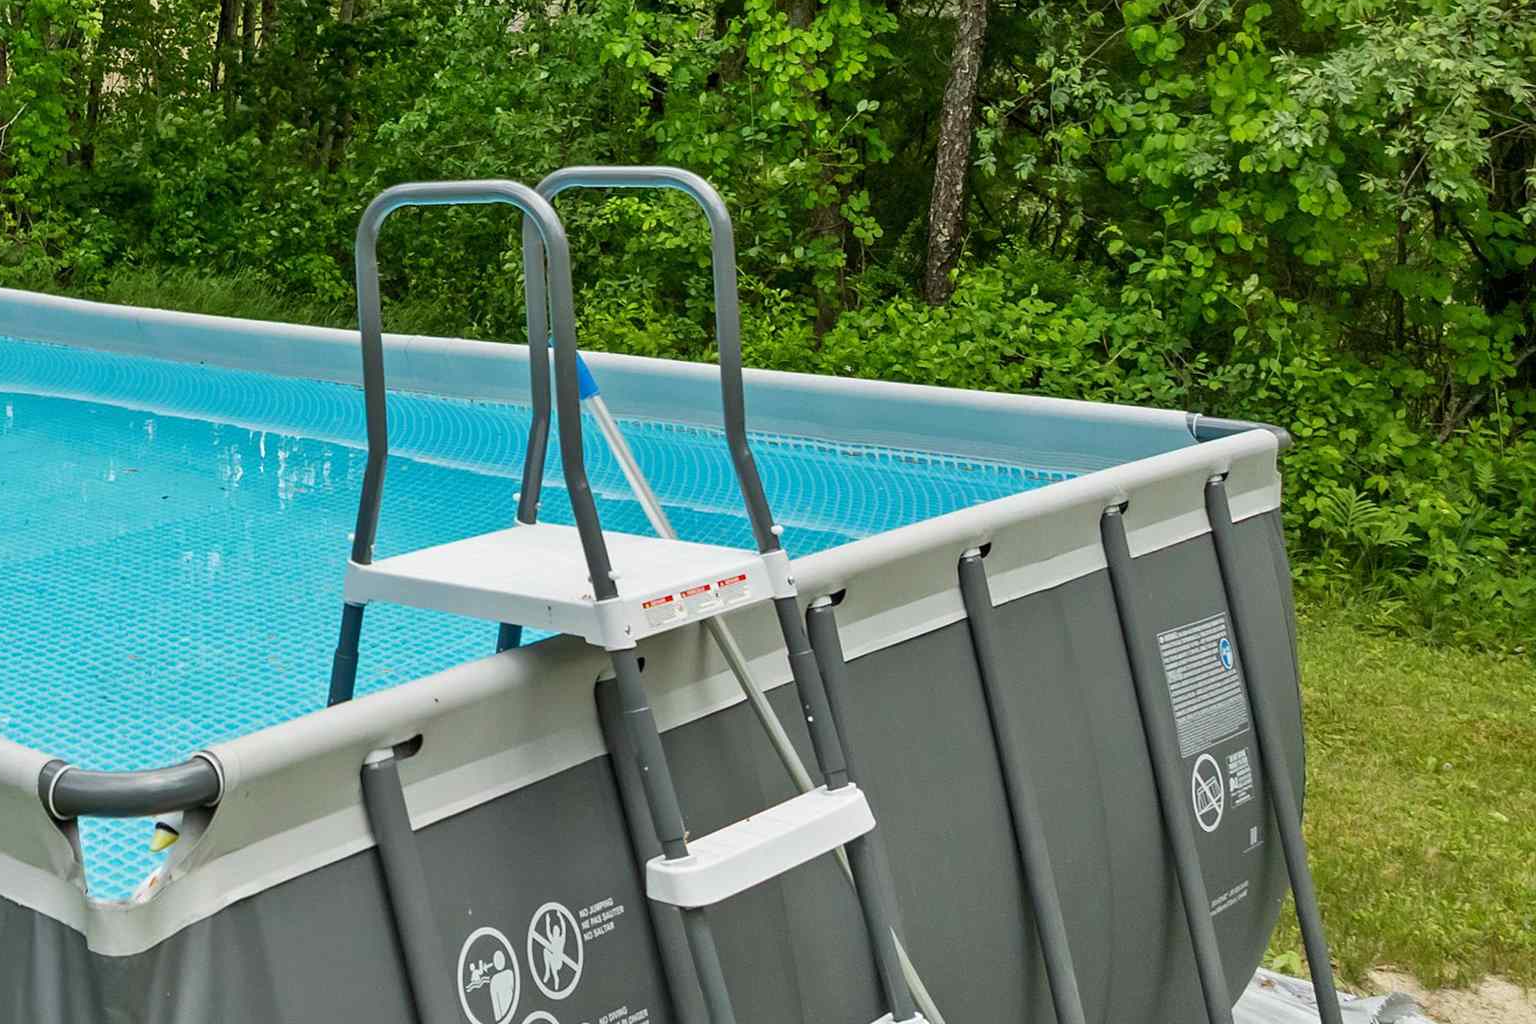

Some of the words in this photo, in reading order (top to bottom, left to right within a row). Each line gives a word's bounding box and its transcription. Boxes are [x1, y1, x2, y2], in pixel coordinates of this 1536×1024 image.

[579, 908, 589, 918] NO
[589, 897, 614, 915] JUMPING
[583, 931, 593, 942] NO
